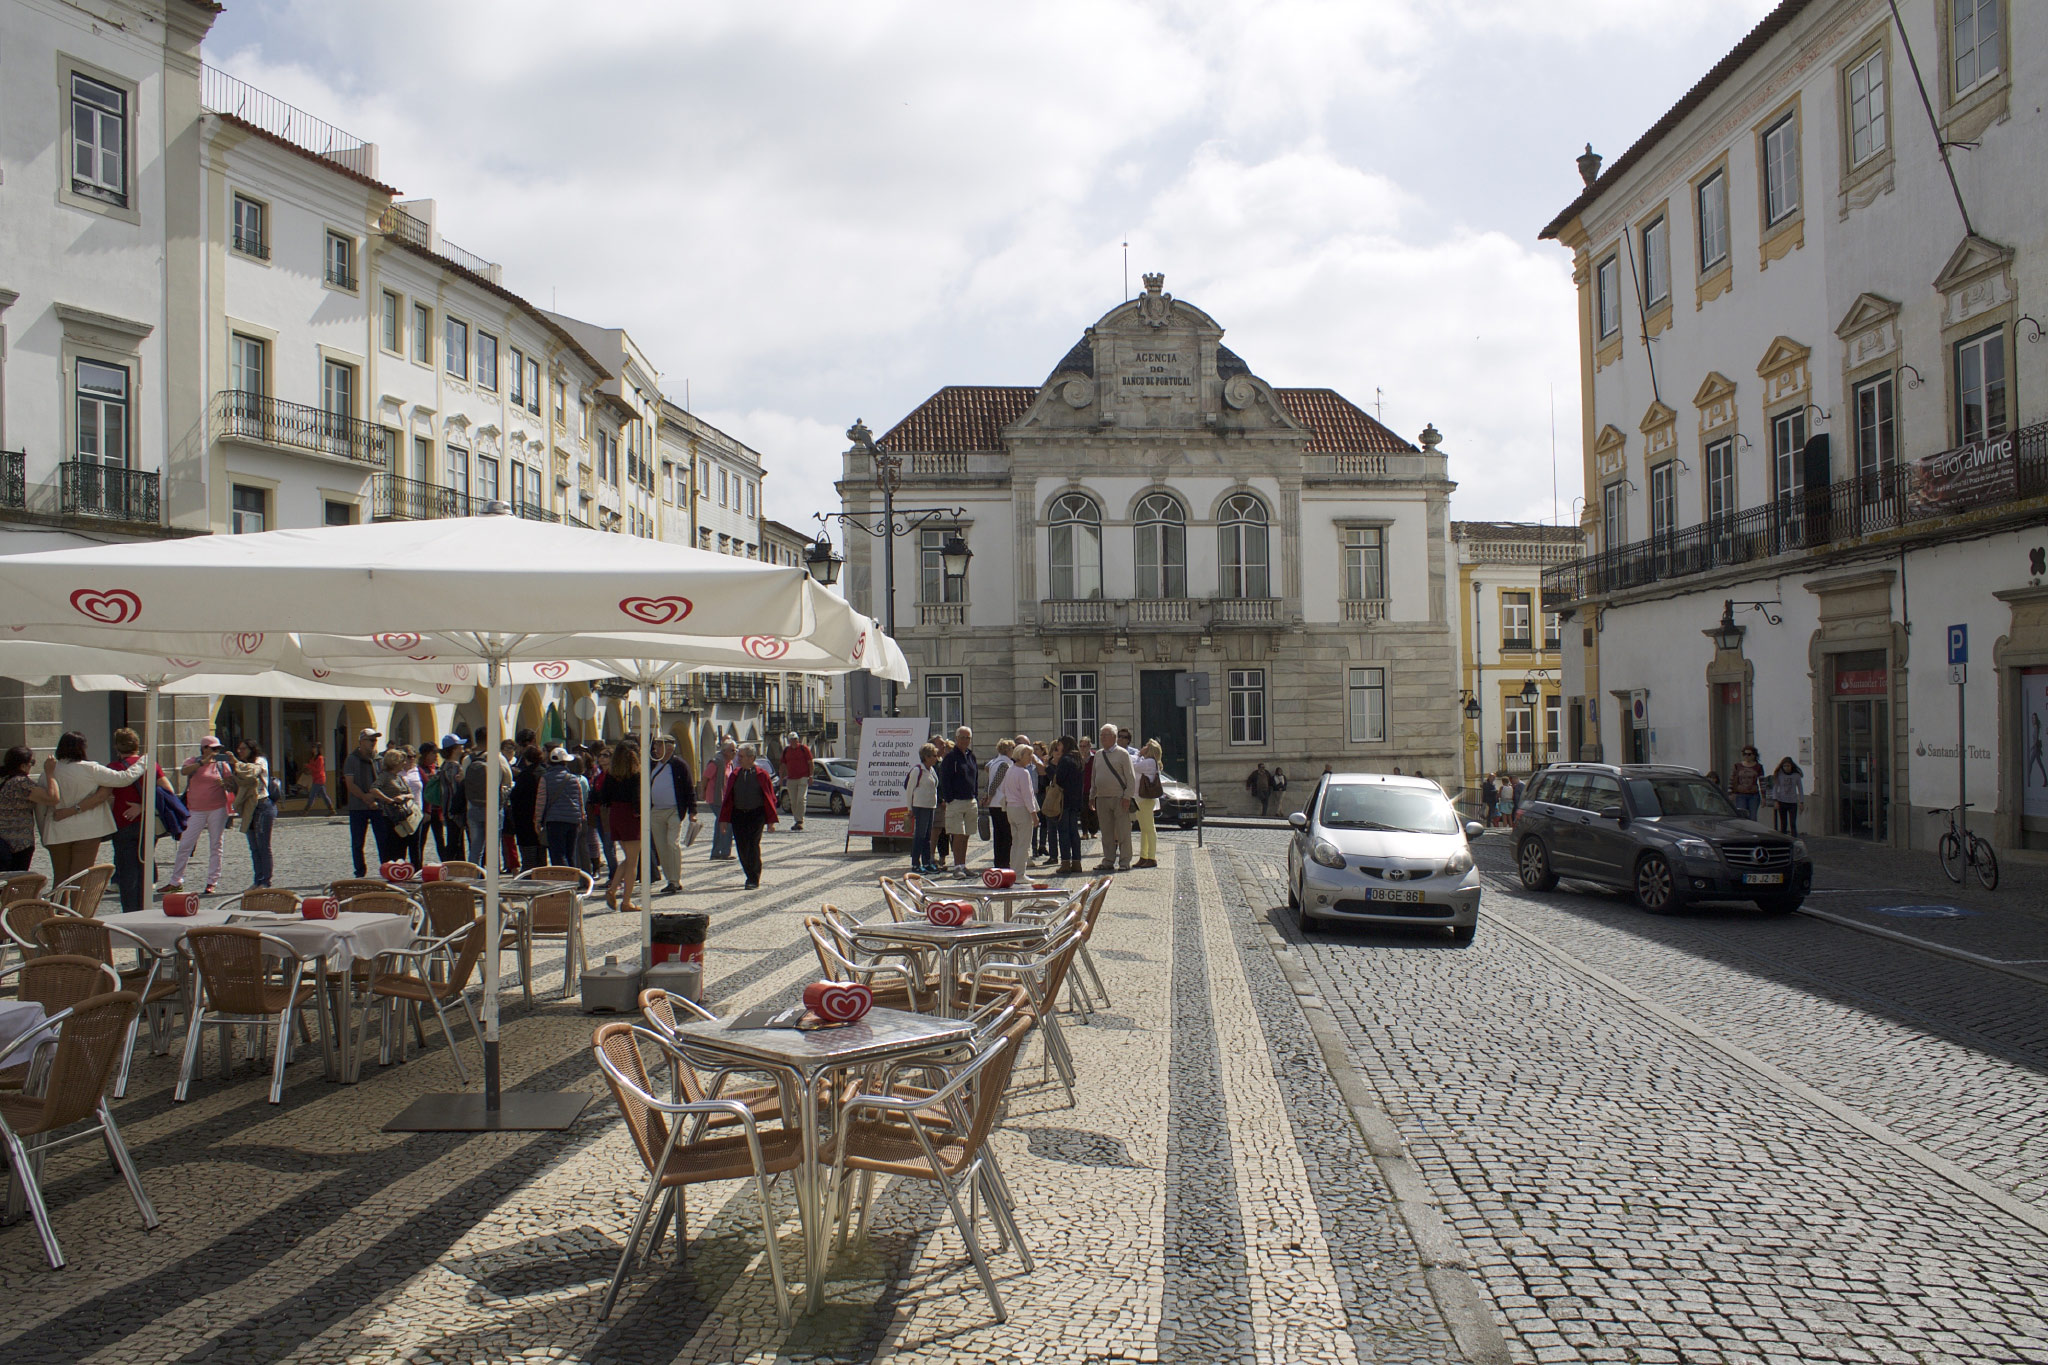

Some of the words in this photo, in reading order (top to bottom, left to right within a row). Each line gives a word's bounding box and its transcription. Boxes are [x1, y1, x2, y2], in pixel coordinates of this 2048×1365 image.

[1122, 376, 1145, 386] BANCO
[1146, 376, 1154, 386] DE
[1155, 376, 1191, 386] PORTUGAL
[1951, 629, 1964, 660] P
[1849, 676, 1877, 689] Santander
[872, 740, 877, 748] A
[878, 740, 894, 748] cada
[895, 740, 914, 749] posto
[1968, 745, 1991, 759] Totta
